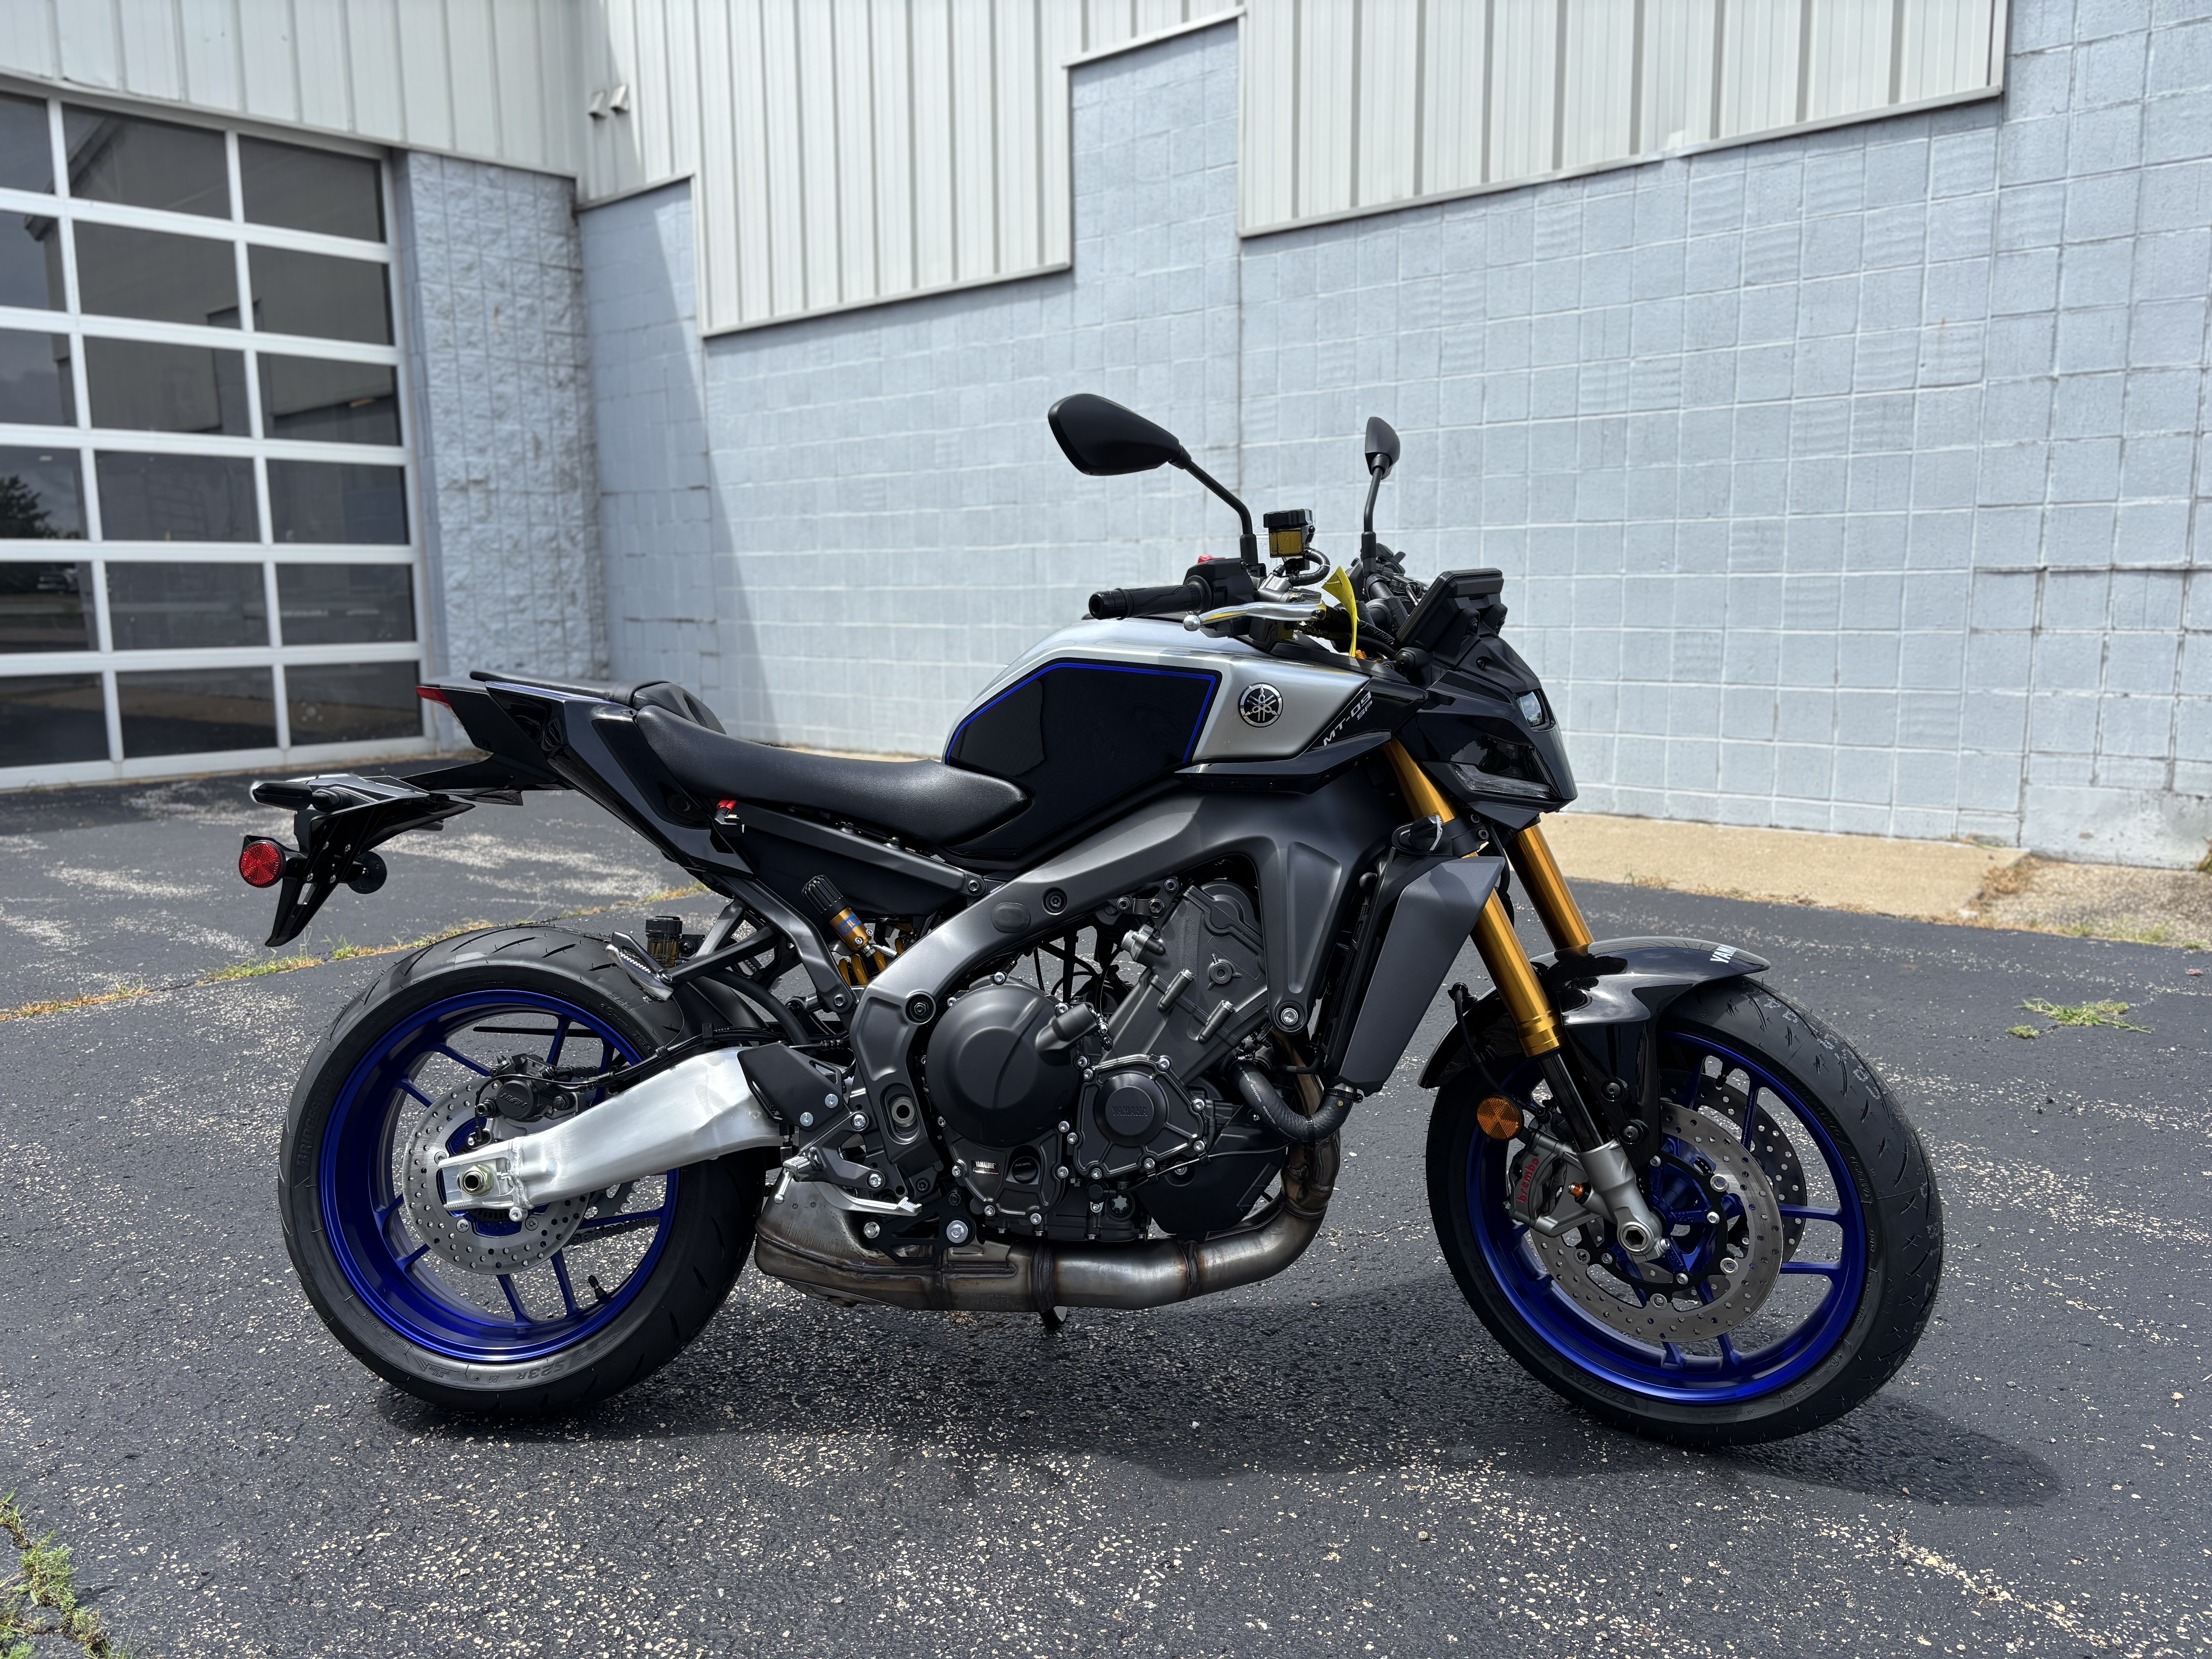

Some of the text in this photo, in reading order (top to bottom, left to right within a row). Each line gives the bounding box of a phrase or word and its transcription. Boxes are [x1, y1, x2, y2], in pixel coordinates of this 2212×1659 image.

[1323, 691, 1371, 746] MT-09
[1357, 700, 1372, 720] SP
[1111, 1106, 1147, 1116] YAMAHA
[1516, 1158, 1539, 1203] brembo
[516, 1360, 565, 1380] S23R
[1568, 1370, 1628, 1403] BATTLAX
